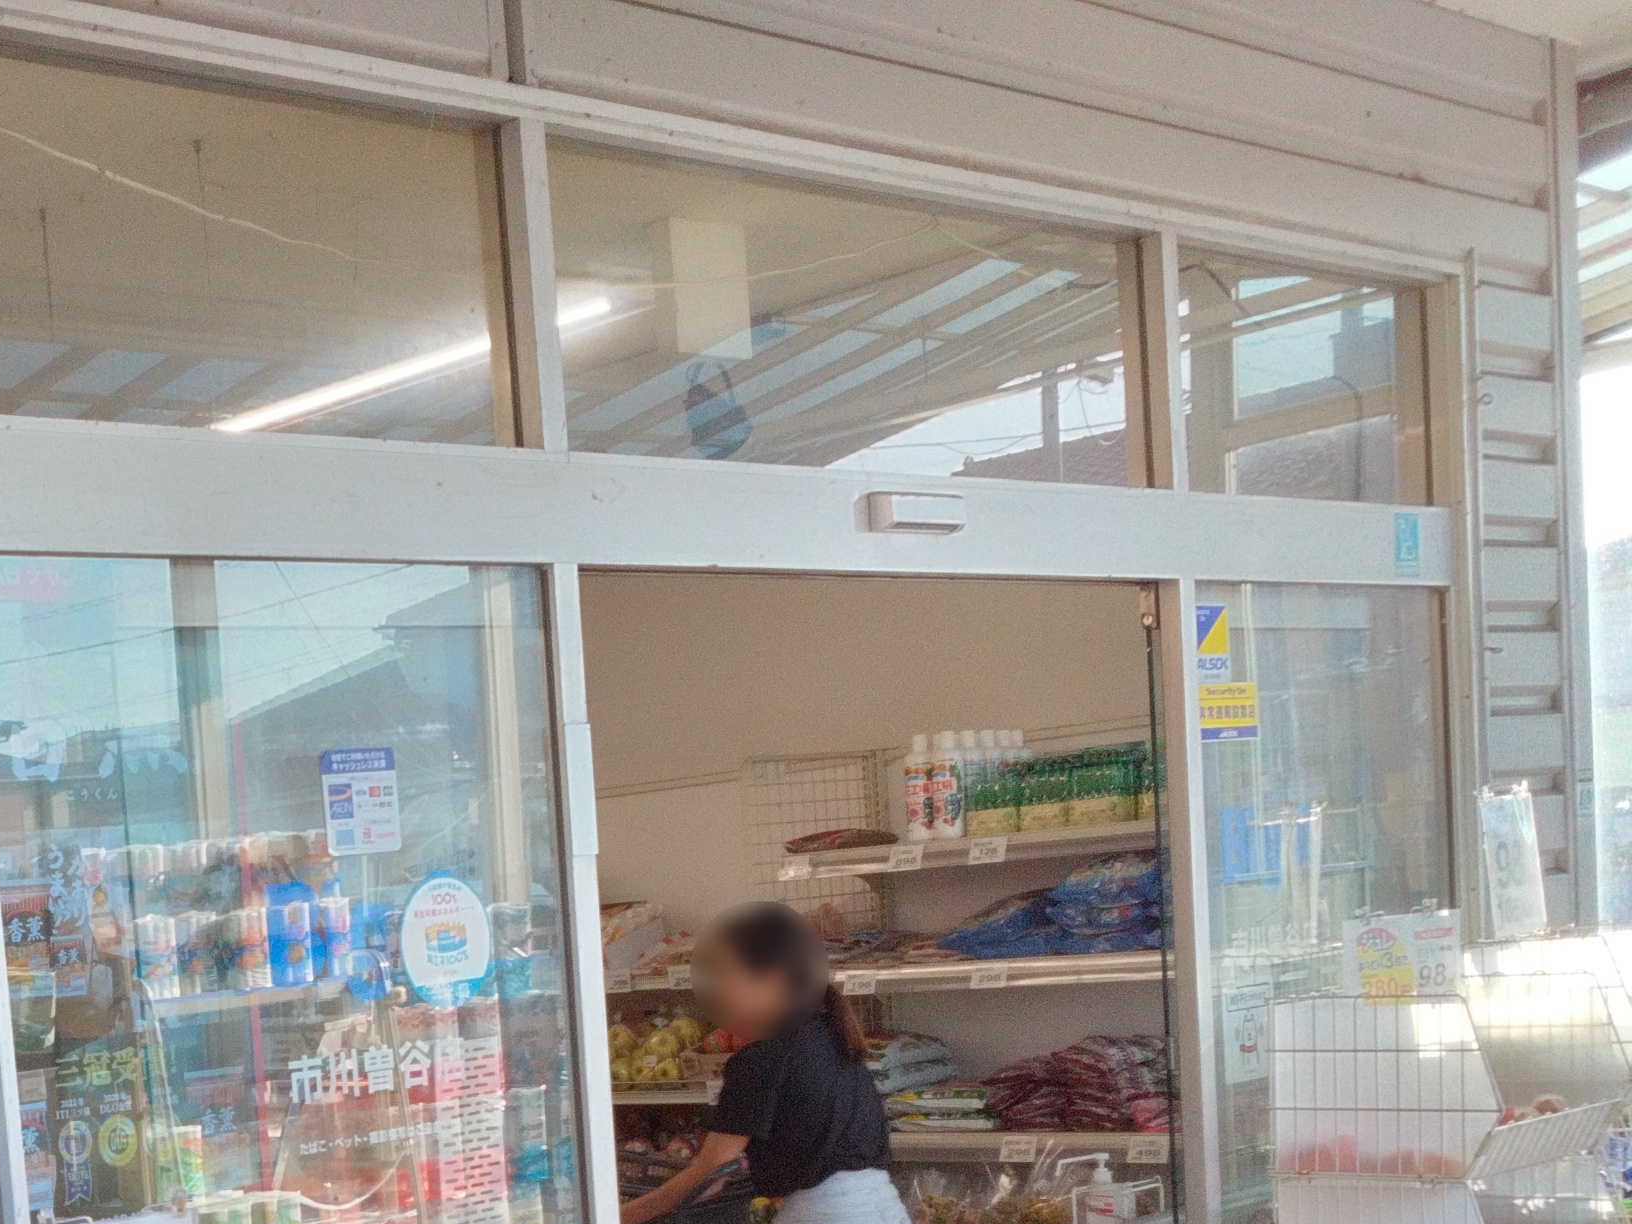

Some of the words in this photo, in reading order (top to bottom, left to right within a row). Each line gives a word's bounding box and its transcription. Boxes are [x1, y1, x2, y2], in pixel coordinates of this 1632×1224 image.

[7, 917, 45, 944] 香薫
[1418, 963, 1447, 987] 98
[287, 1035, 466, 1105] 市川曽谷店
